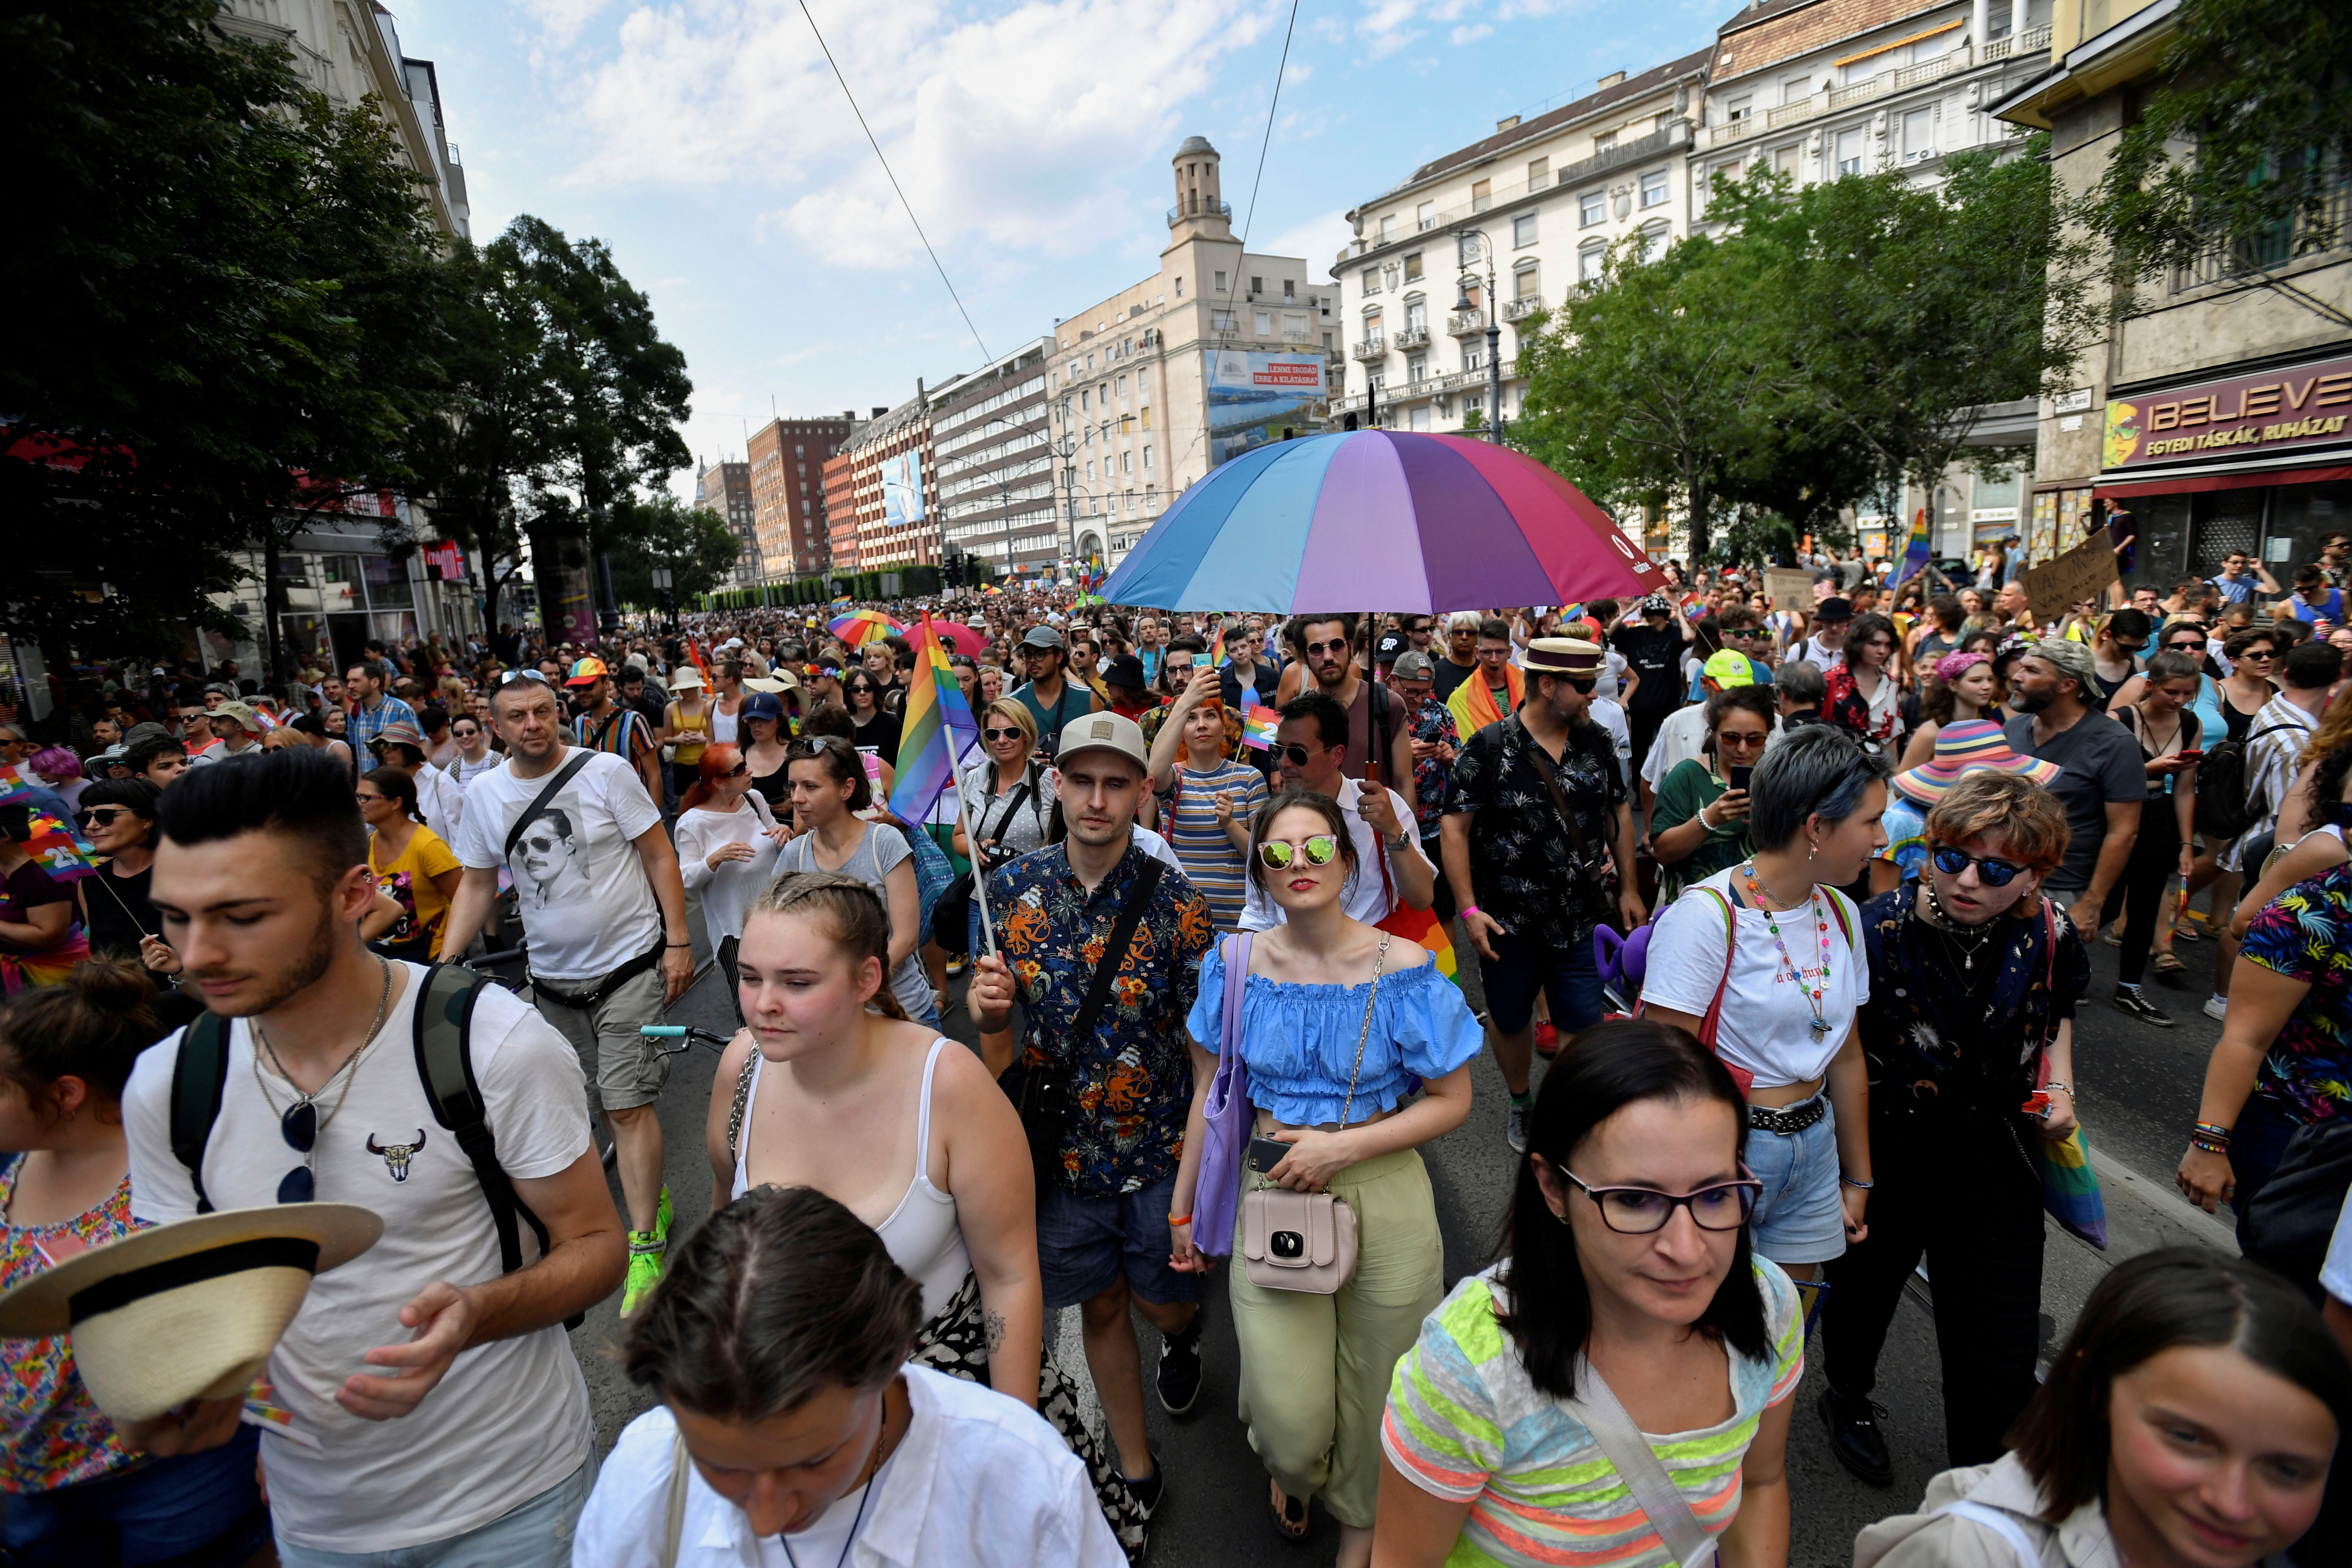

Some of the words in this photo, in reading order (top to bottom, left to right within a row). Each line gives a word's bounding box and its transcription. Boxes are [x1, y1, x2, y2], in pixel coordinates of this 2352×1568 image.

[1279, 375, 1318, 383] KILÁTÁSRA?
[2146, 436, 2195, 456] EGYEDI
[2196, 425, 2260, 449] TÁSKÁK,
[2262, 415, 2348, 441] RUHÁZAT
[1683, 601, 1697, 617] 25
[1381, 637, 1398, 651] BP
[259, 712, 276, 727] 25
[1259, 722, 1278, 741] 2
[0, 778, 14, 797] 5
[44, 846, 79, 868] 25
[1777, 974, 1784, 983] u
